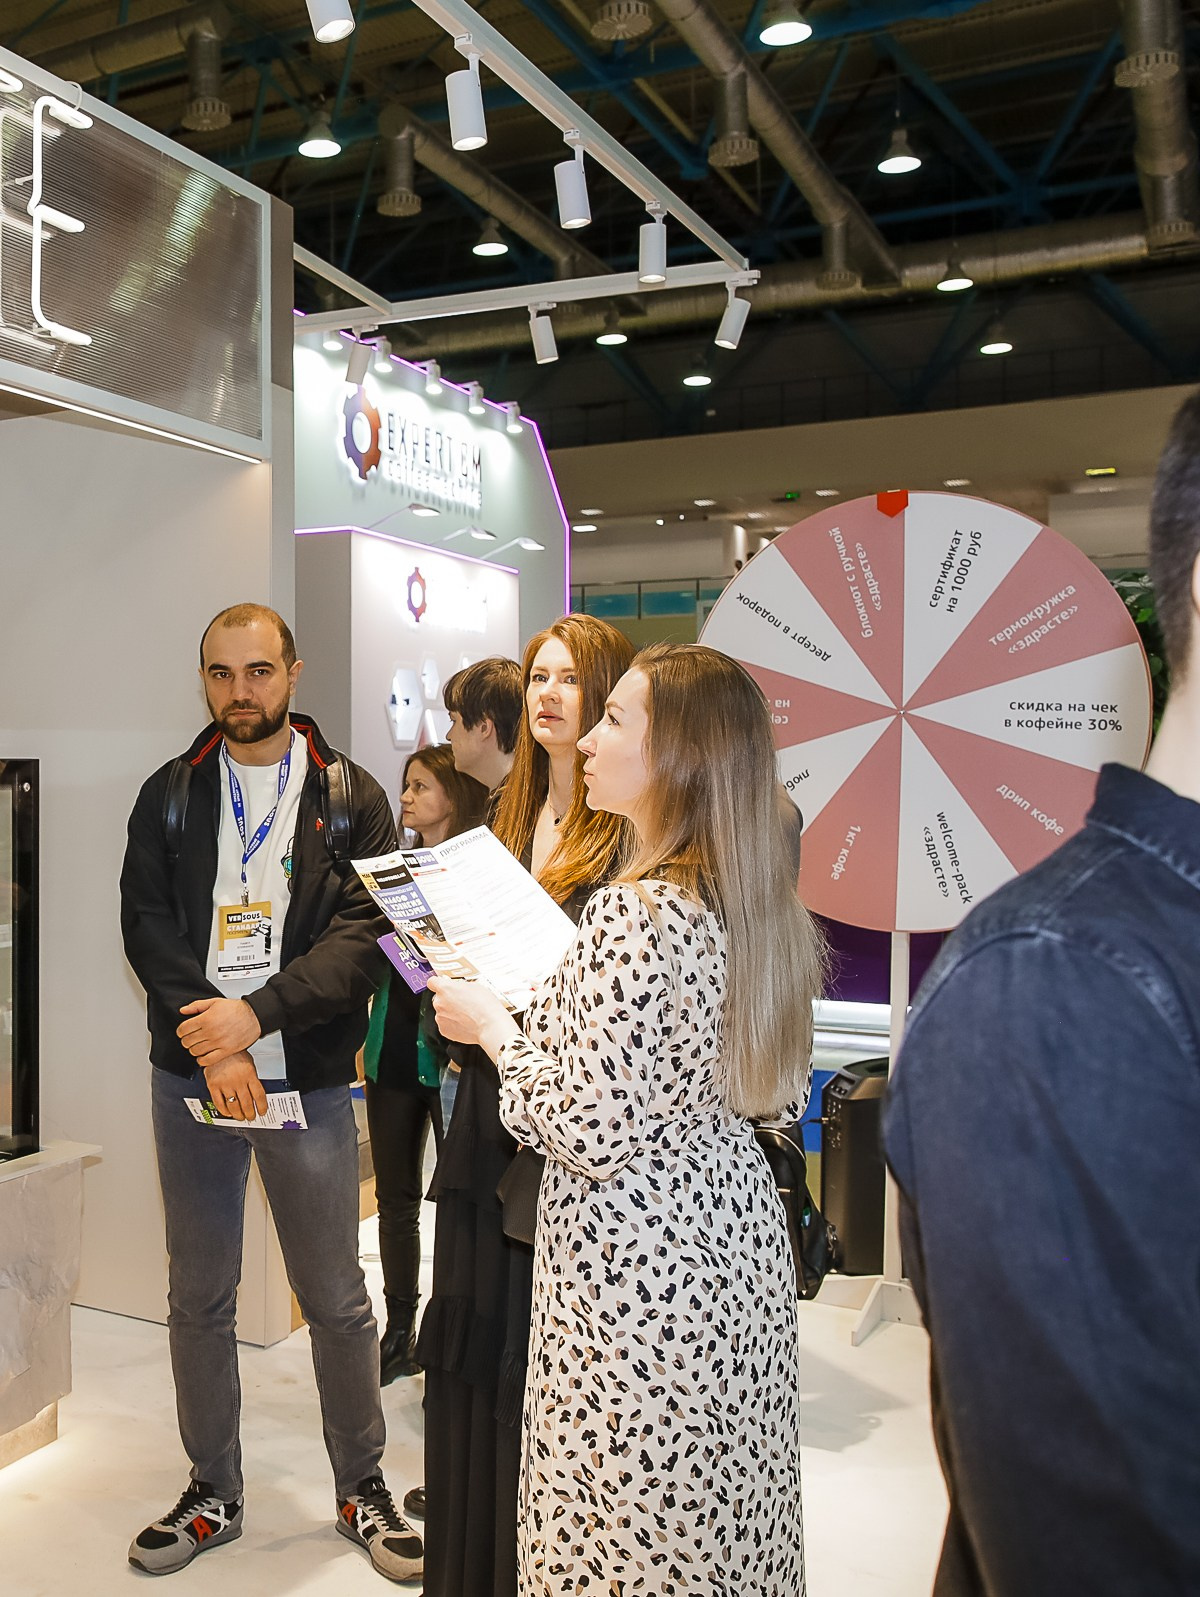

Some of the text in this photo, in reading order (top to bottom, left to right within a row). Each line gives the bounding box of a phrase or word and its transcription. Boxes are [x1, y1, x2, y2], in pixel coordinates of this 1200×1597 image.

[388, 412, 452, 472] EXPERT
[828, 526, 874, 638] блокнот с ручкой
[855, 542, 882, 611] «здрасте»
[928, 529, 964, 608] сертификат
[946, 530, 982, 613] на 1000 руб
[736, 592, 832, 662] десерт в подарок
[988, 584, 1077, 646] термокружка
[1008, 605, 1078, 654] «здрасте»
[1004, 718, 1123, 731] в кофейне 30%
[1009, 701, 1118, 714] скидка на чек
[783, 768, 810, 791] люб
[996, 784, 1065, 836] дрип кофе
[440, 831, 489, 858] ПРОГРАММА
[831, 849, 850, 881] кофе
[923, 826, 950, 898] «здрасте»
[936, 811, 973, 904] welcome-pack
